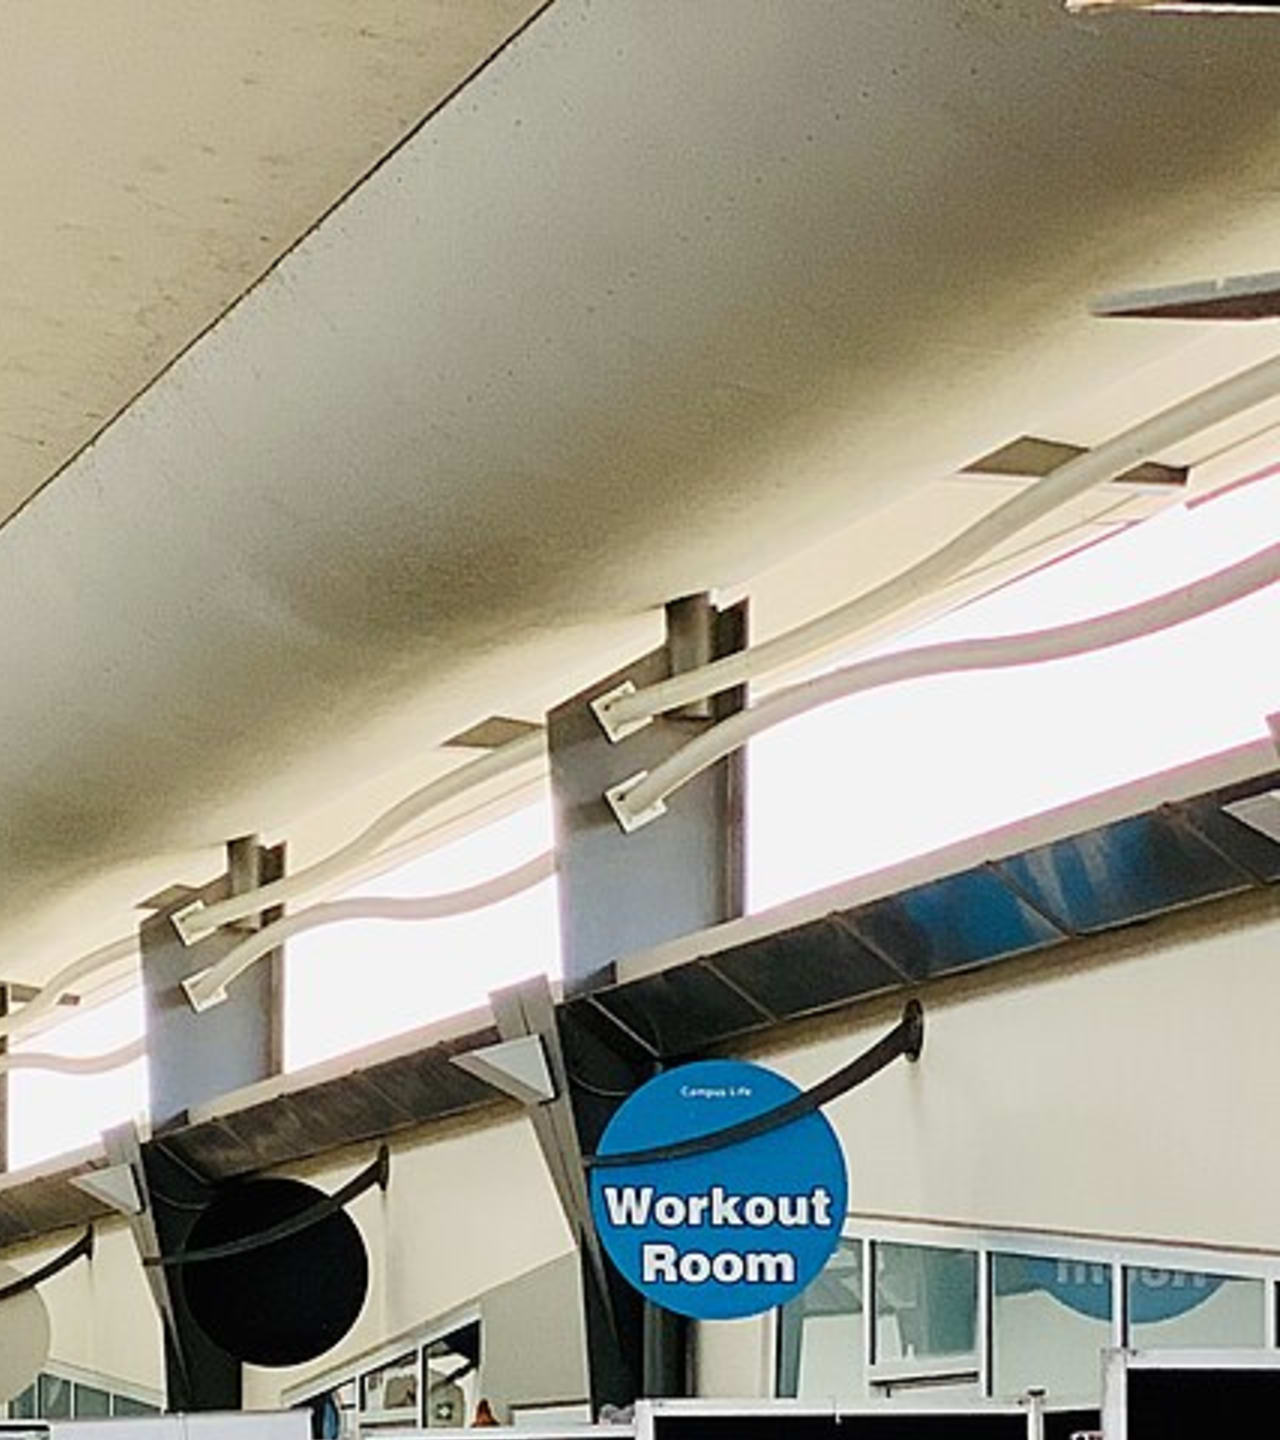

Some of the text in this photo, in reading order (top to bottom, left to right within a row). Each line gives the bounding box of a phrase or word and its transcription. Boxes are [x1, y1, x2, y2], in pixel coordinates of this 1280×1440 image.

[680, 1084, 752, 1098] Campus Life
[603, 1186, 833, 1226] Workout
[642, 1244, 795, 1282] Room
